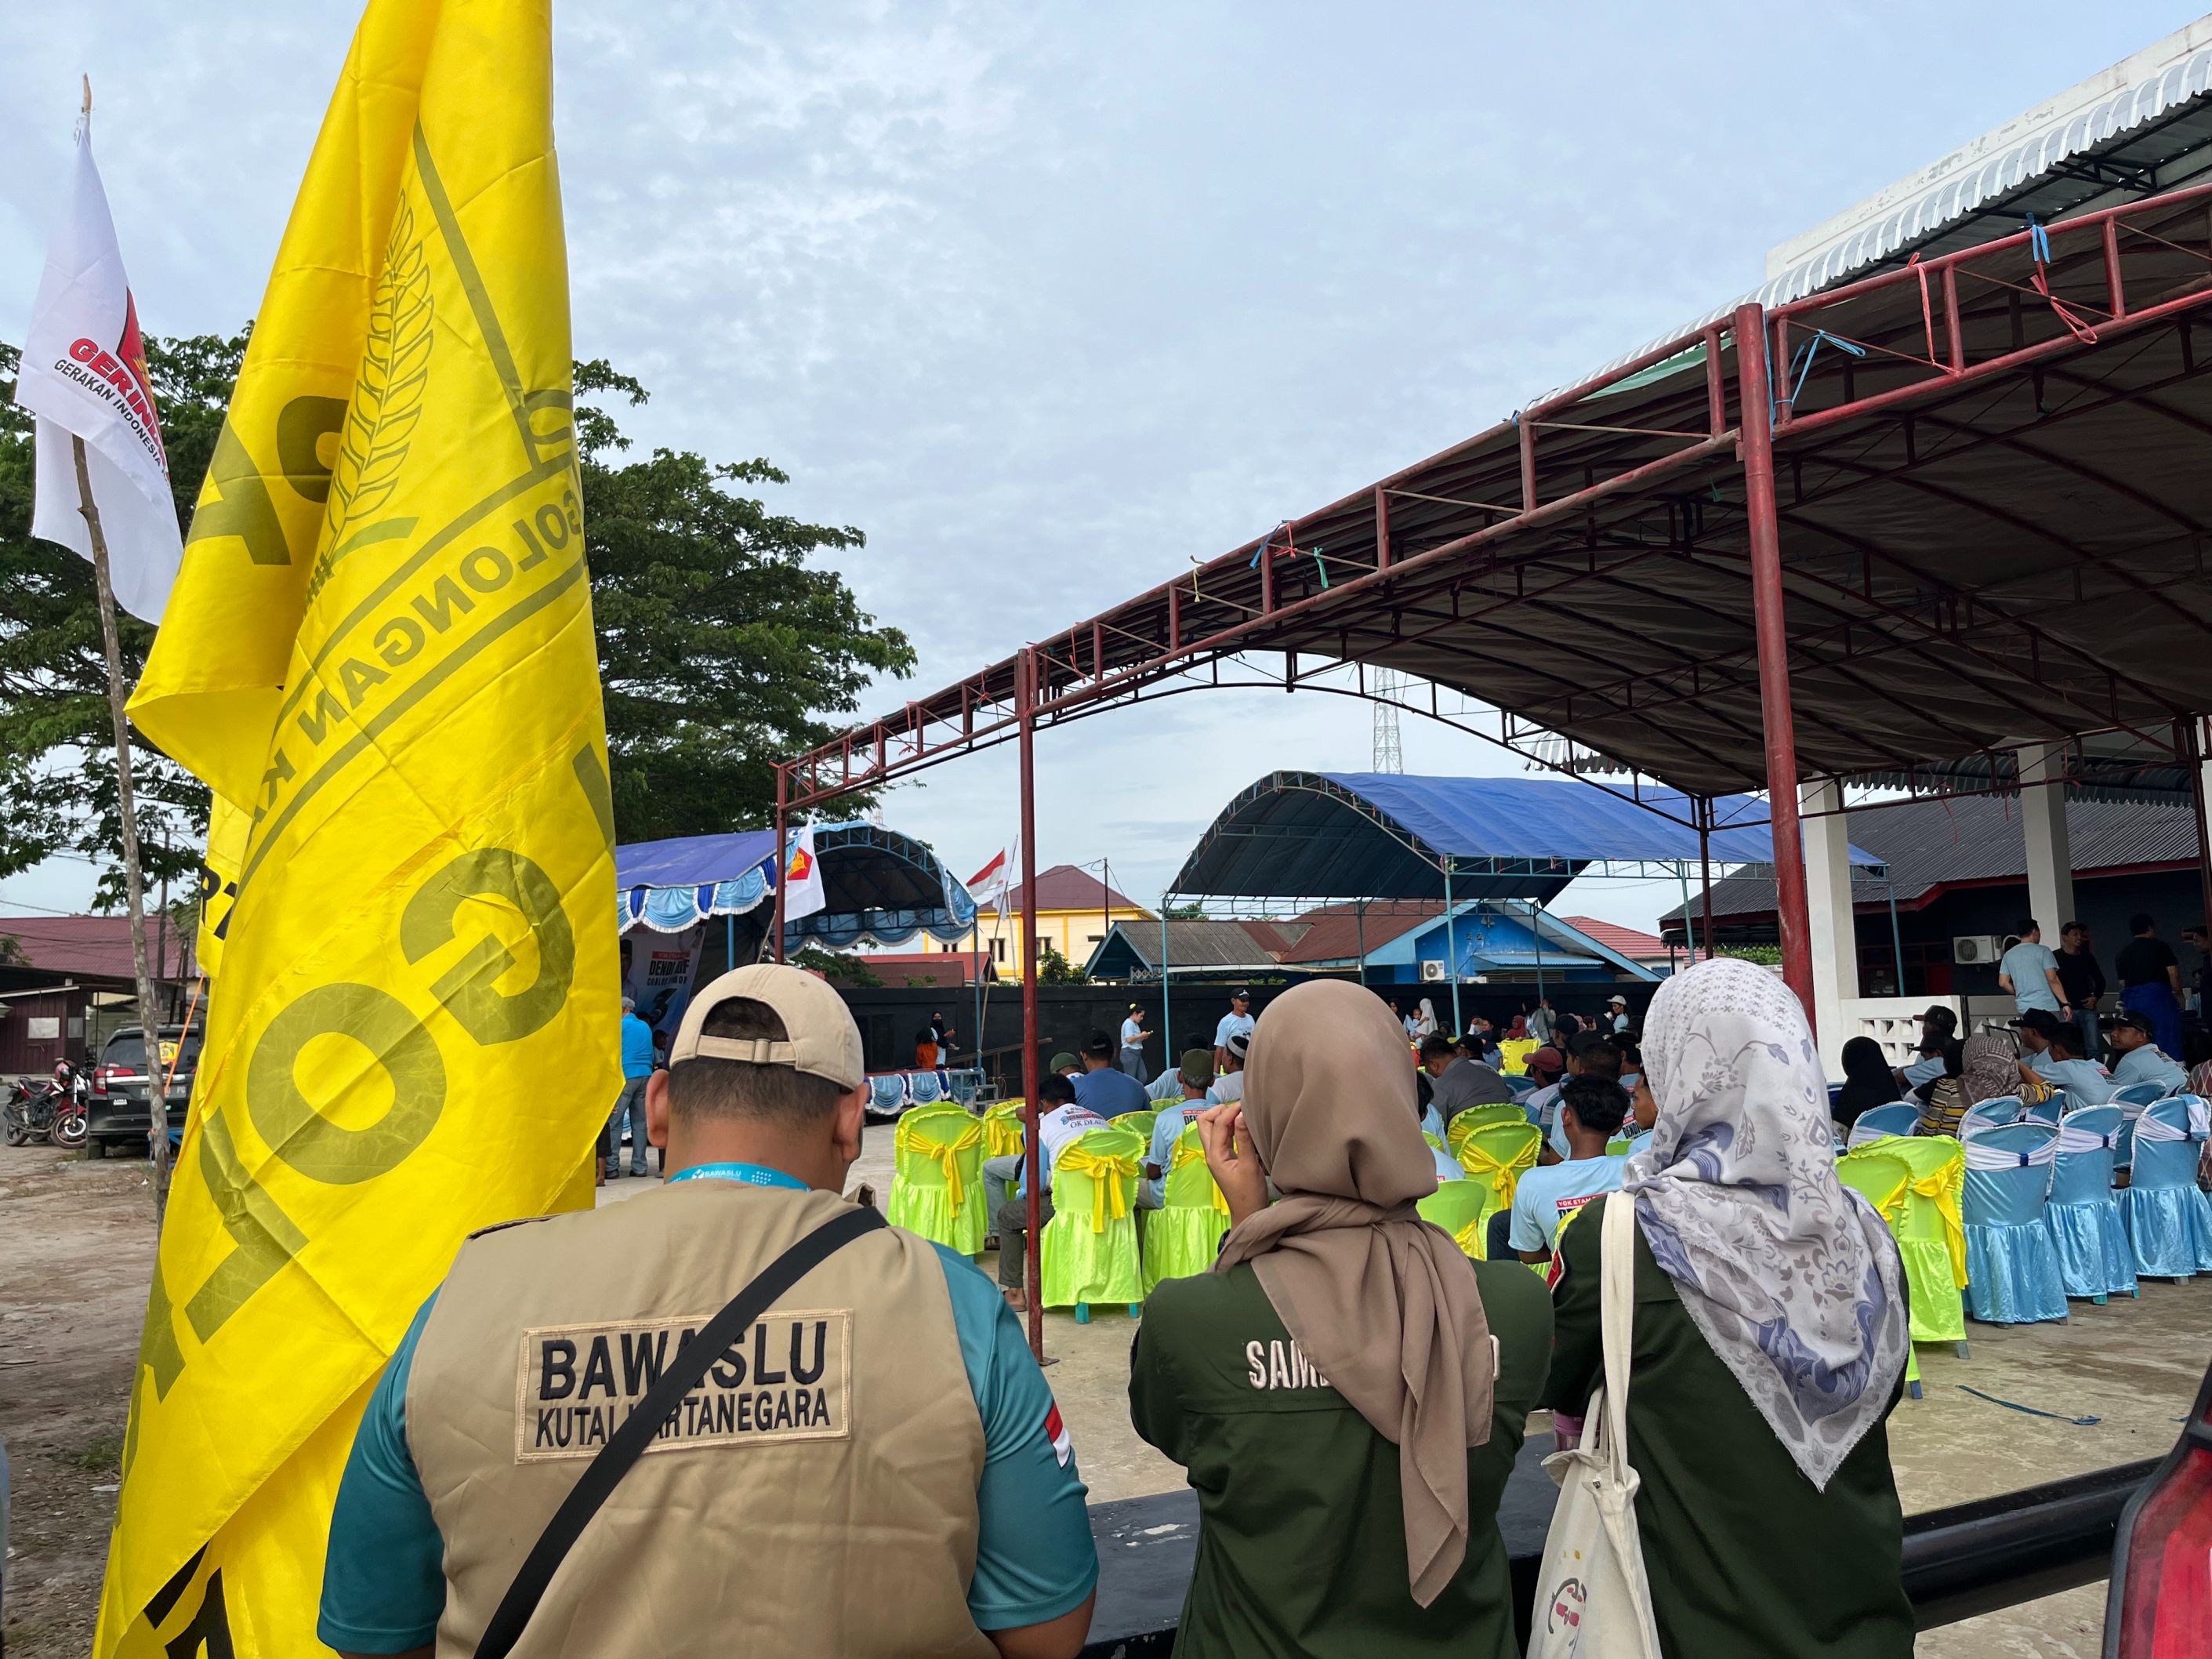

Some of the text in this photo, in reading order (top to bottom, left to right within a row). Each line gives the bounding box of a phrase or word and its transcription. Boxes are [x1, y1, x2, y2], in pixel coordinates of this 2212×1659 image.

[54, 359, 161, 466] GERAKAN INDONESIA
[1246, 1339, 1334, 1390] SAM
[535, 1387, 831, 1448] KUTAI RTANEGARA
